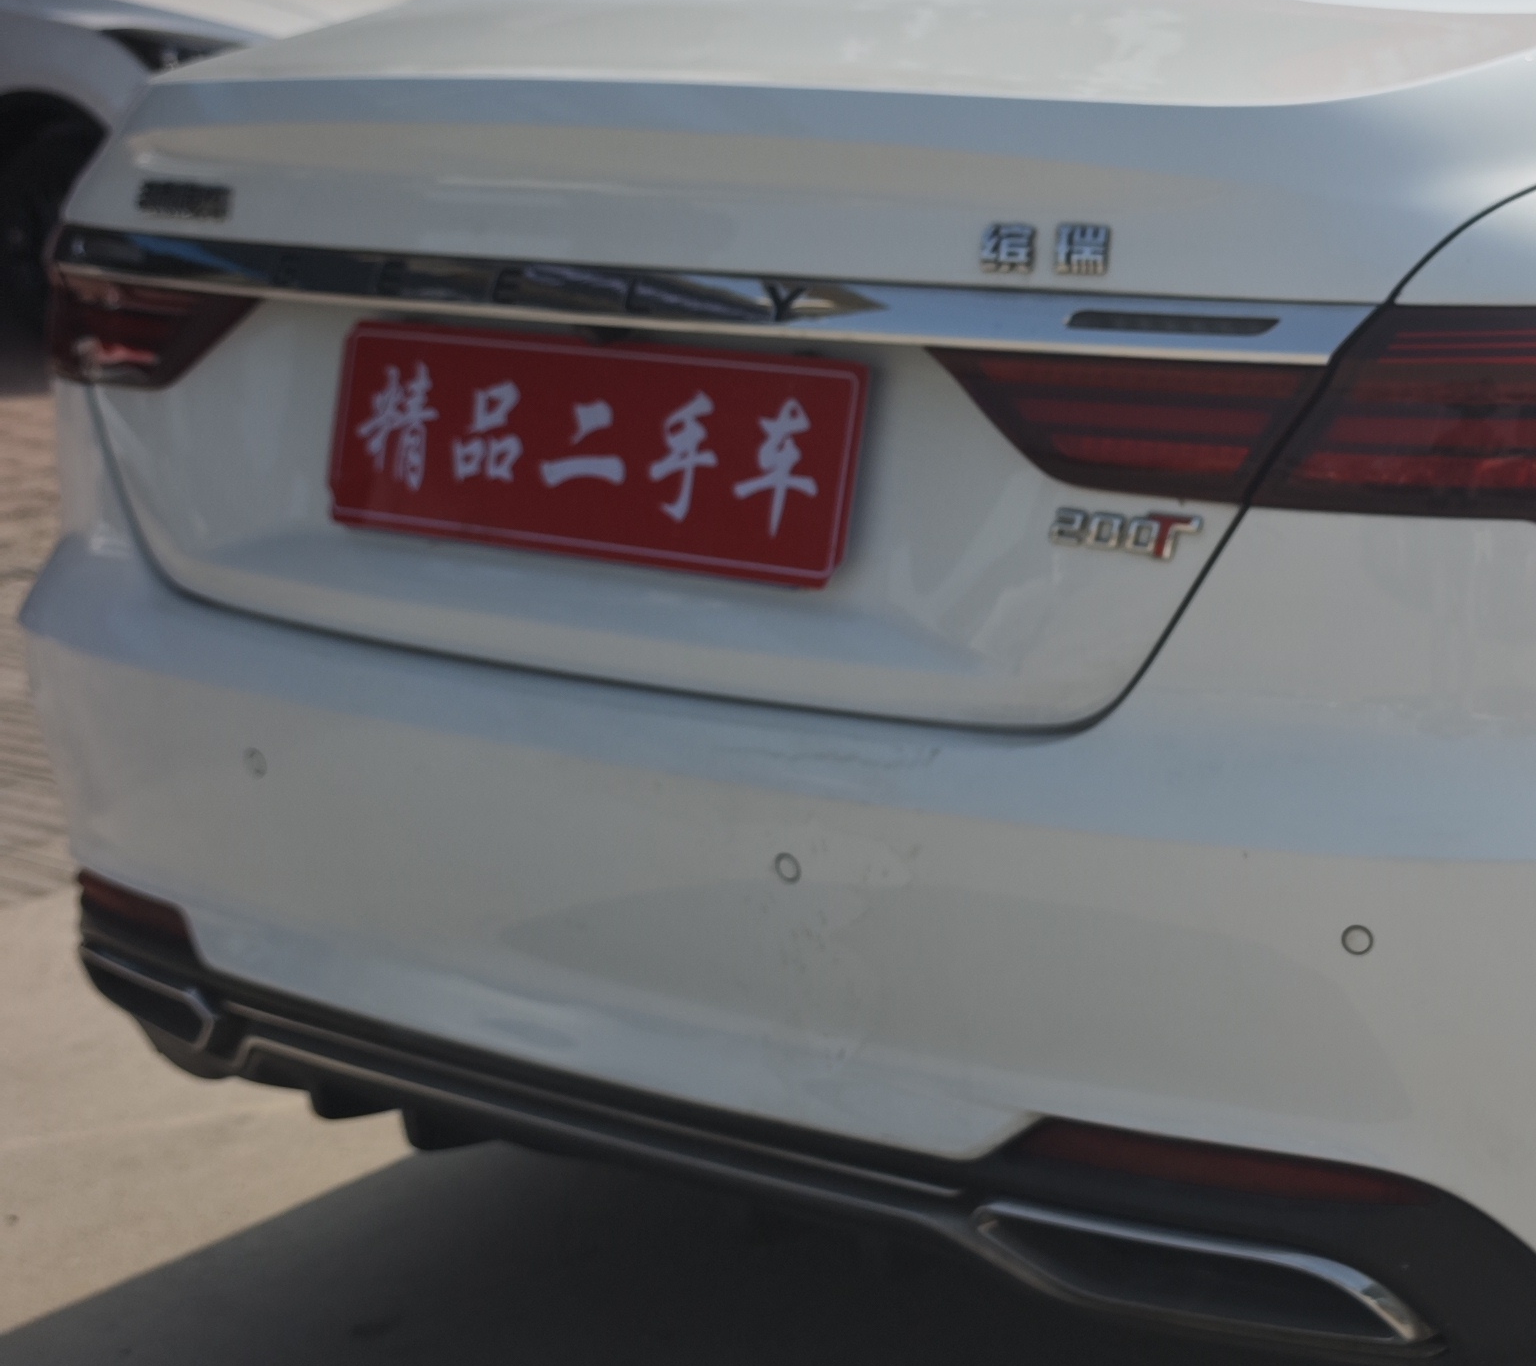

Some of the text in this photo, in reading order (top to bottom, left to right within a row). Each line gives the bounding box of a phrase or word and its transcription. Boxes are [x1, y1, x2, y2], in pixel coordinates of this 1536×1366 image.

[356, 359, 819, 540] 精品二手车
[1050, 506, 1204, 561] 200T
